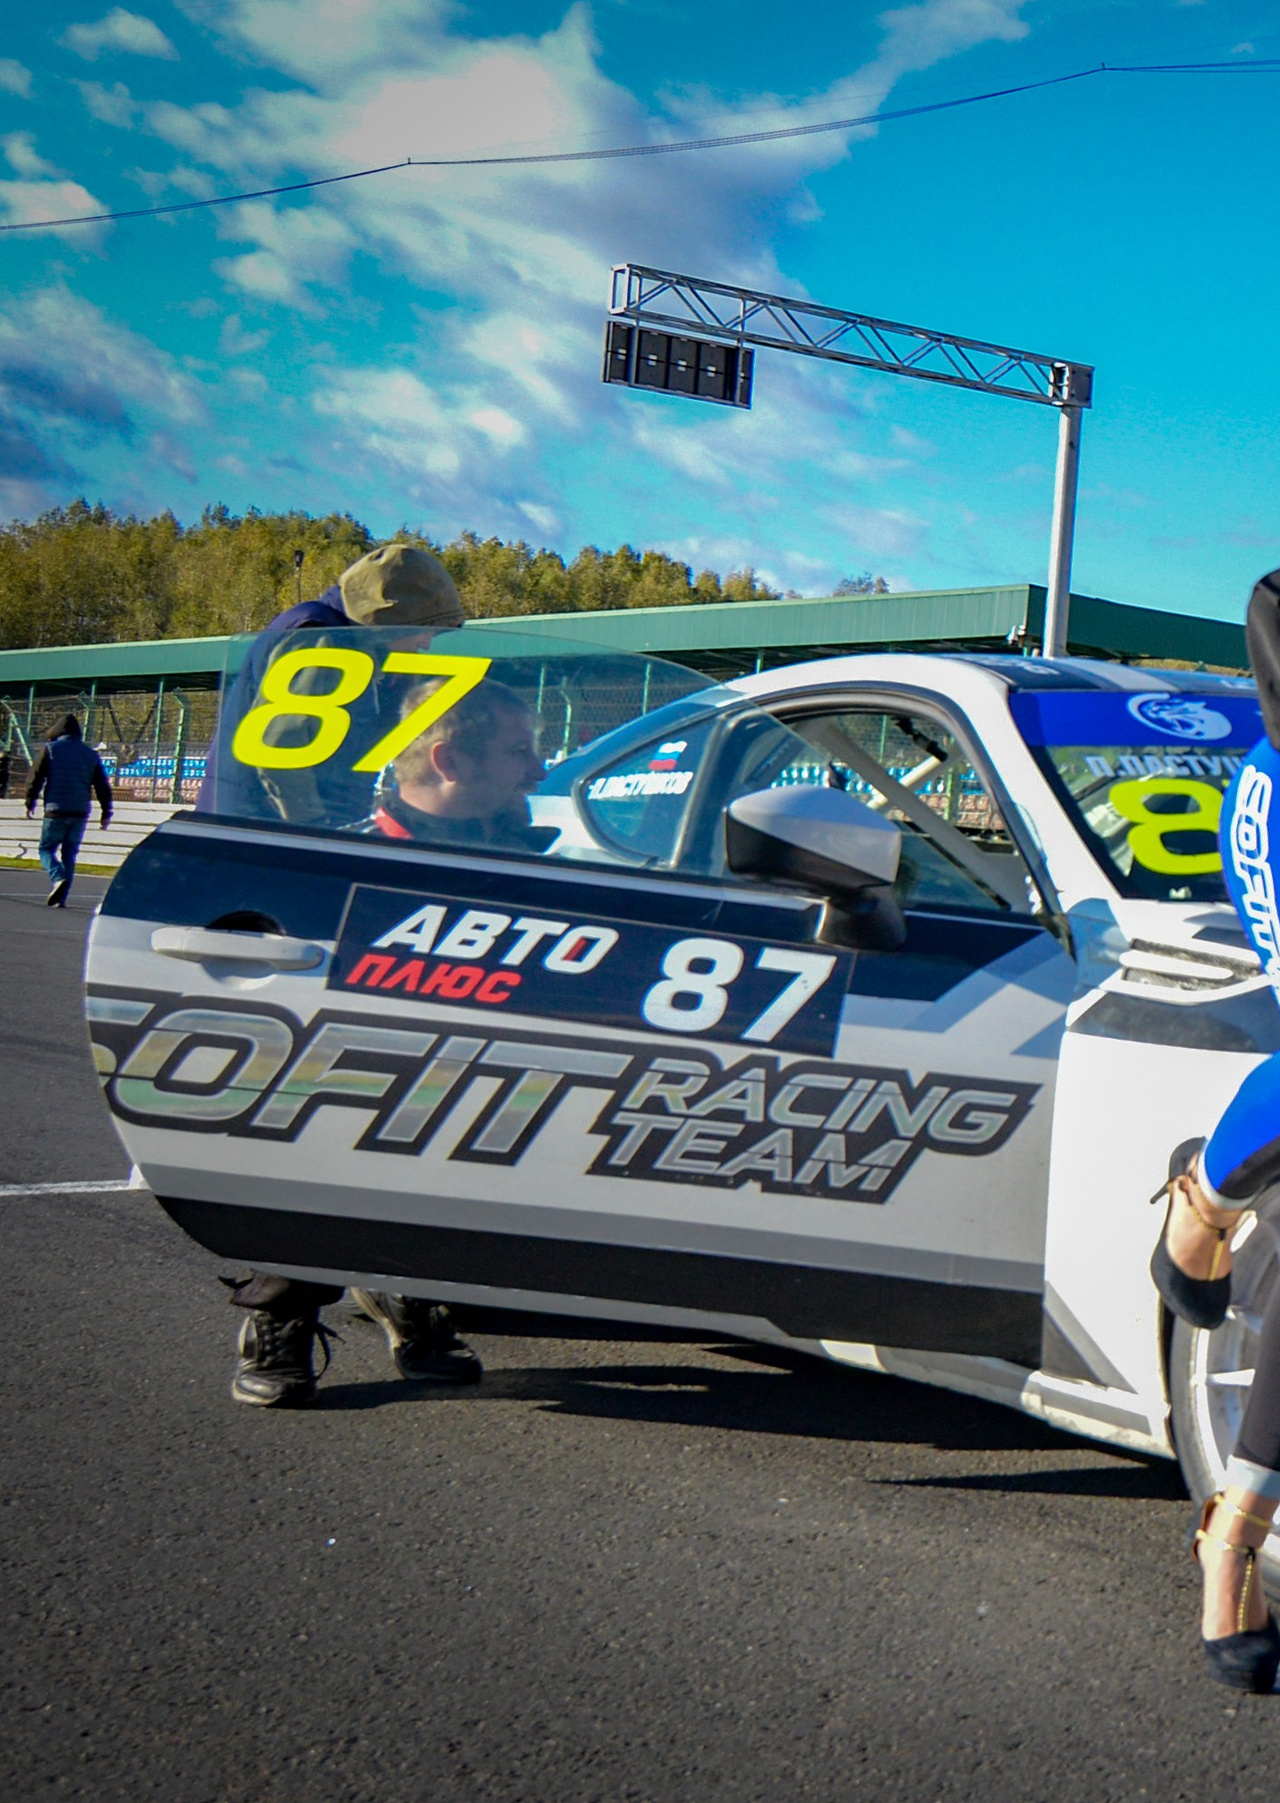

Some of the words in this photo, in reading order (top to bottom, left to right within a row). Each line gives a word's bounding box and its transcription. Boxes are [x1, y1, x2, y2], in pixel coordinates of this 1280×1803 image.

[231, 647, 492, 772] 87
[345, 954, 522, 1003] ПЛЮС
[373, 904, 619, 974] АВТО
[640, 938, 838, 1044] 87
[624, 1056, 1021, 1146] RACING
[608, 1112, 914, 1193] TEAM
